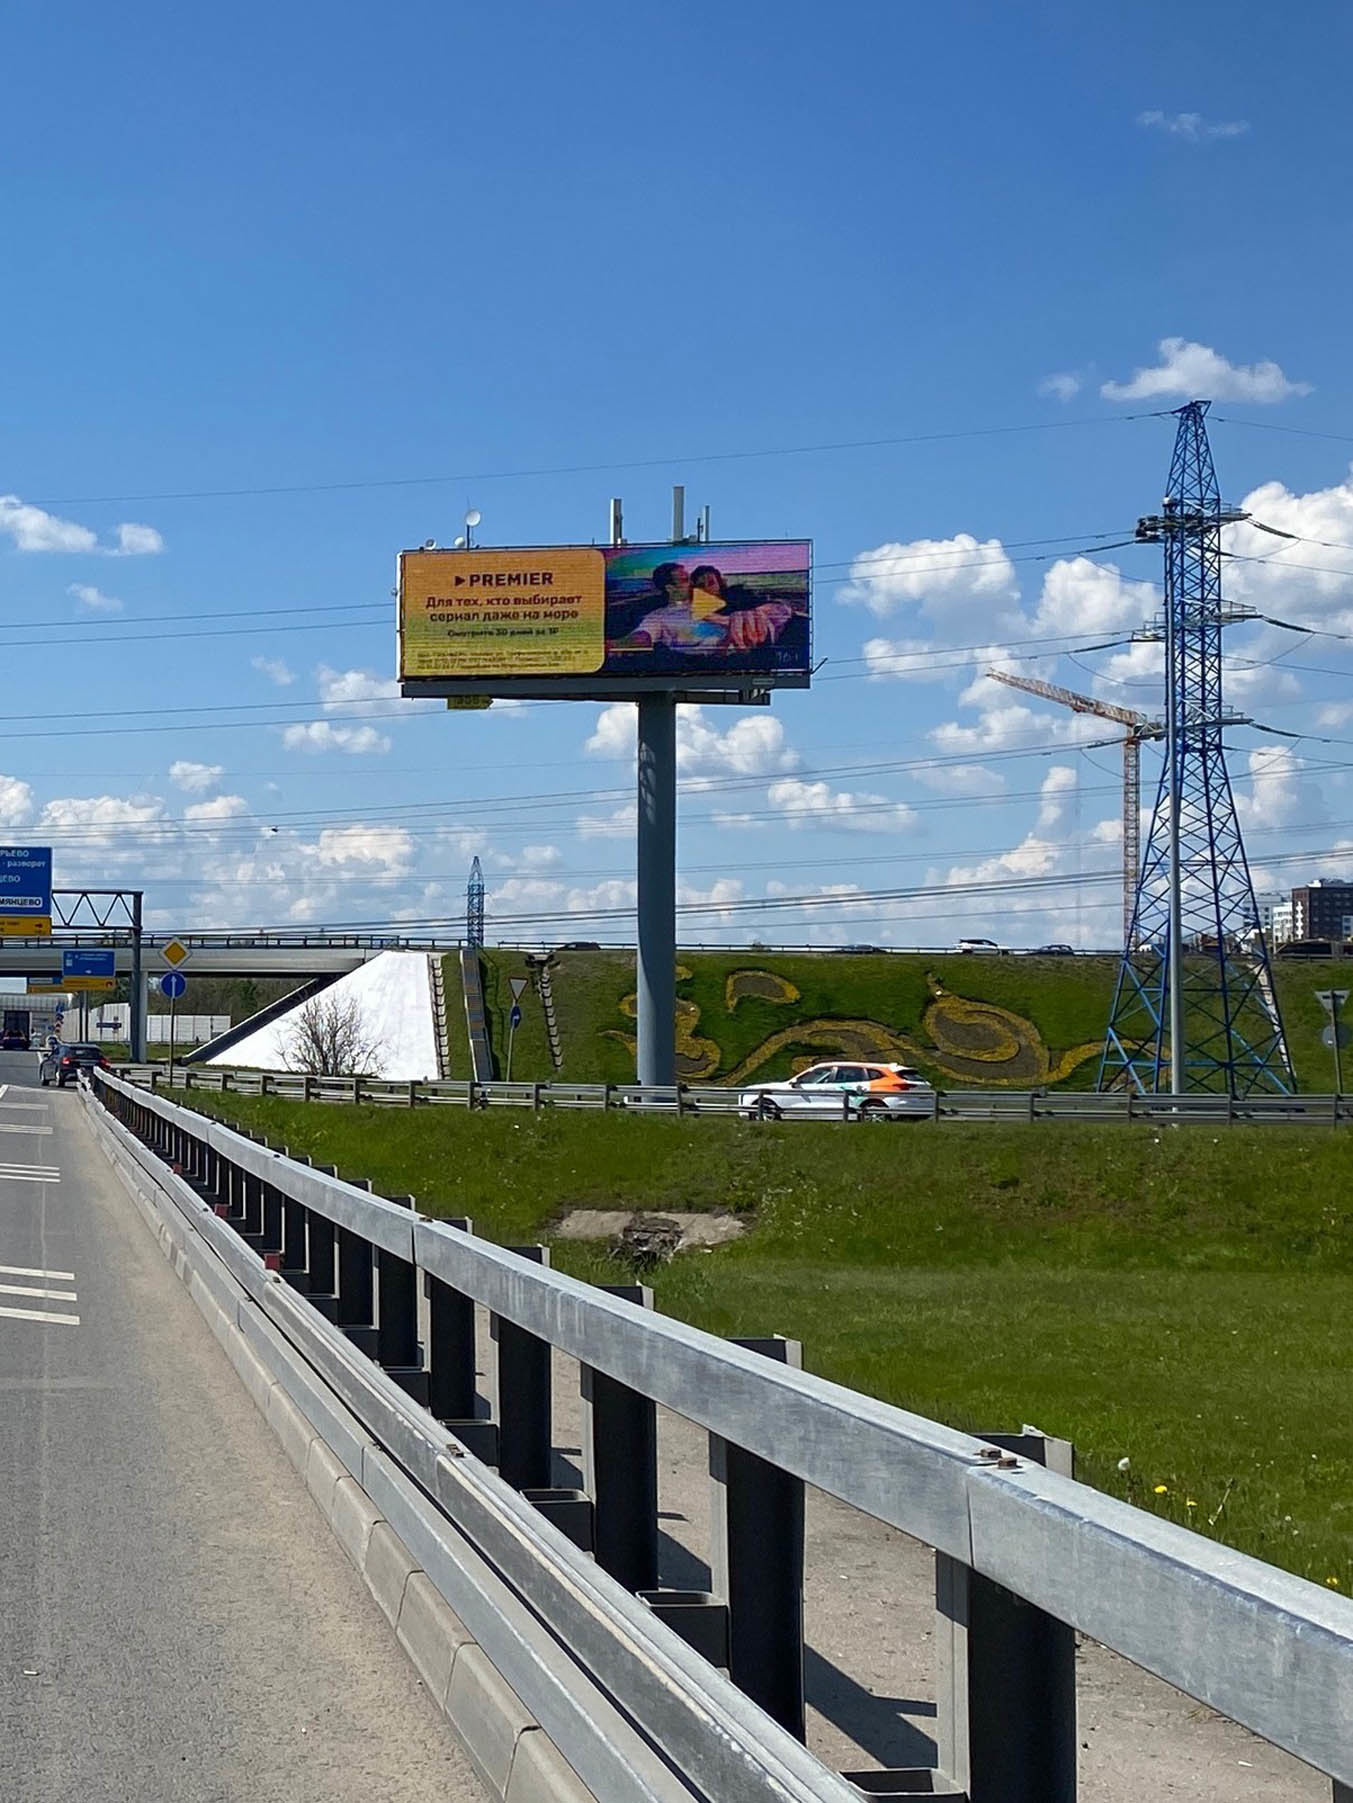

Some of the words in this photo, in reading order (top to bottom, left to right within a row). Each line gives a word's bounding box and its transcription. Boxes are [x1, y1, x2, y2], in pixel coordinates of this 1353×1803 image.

[469, 572, 553, 587] PREMIER
[426, 596, 453, 609] Для
[486, 596, 511, 606] кто
[514, 594, 583, 607] выбирает
[430, 609, 479, 623] сериал
[482, 609, 520, 622] даже
[523, 610, 540, 620] на
[543, 608, 579, 621] море
[7, 861, 46, 869] разворот
